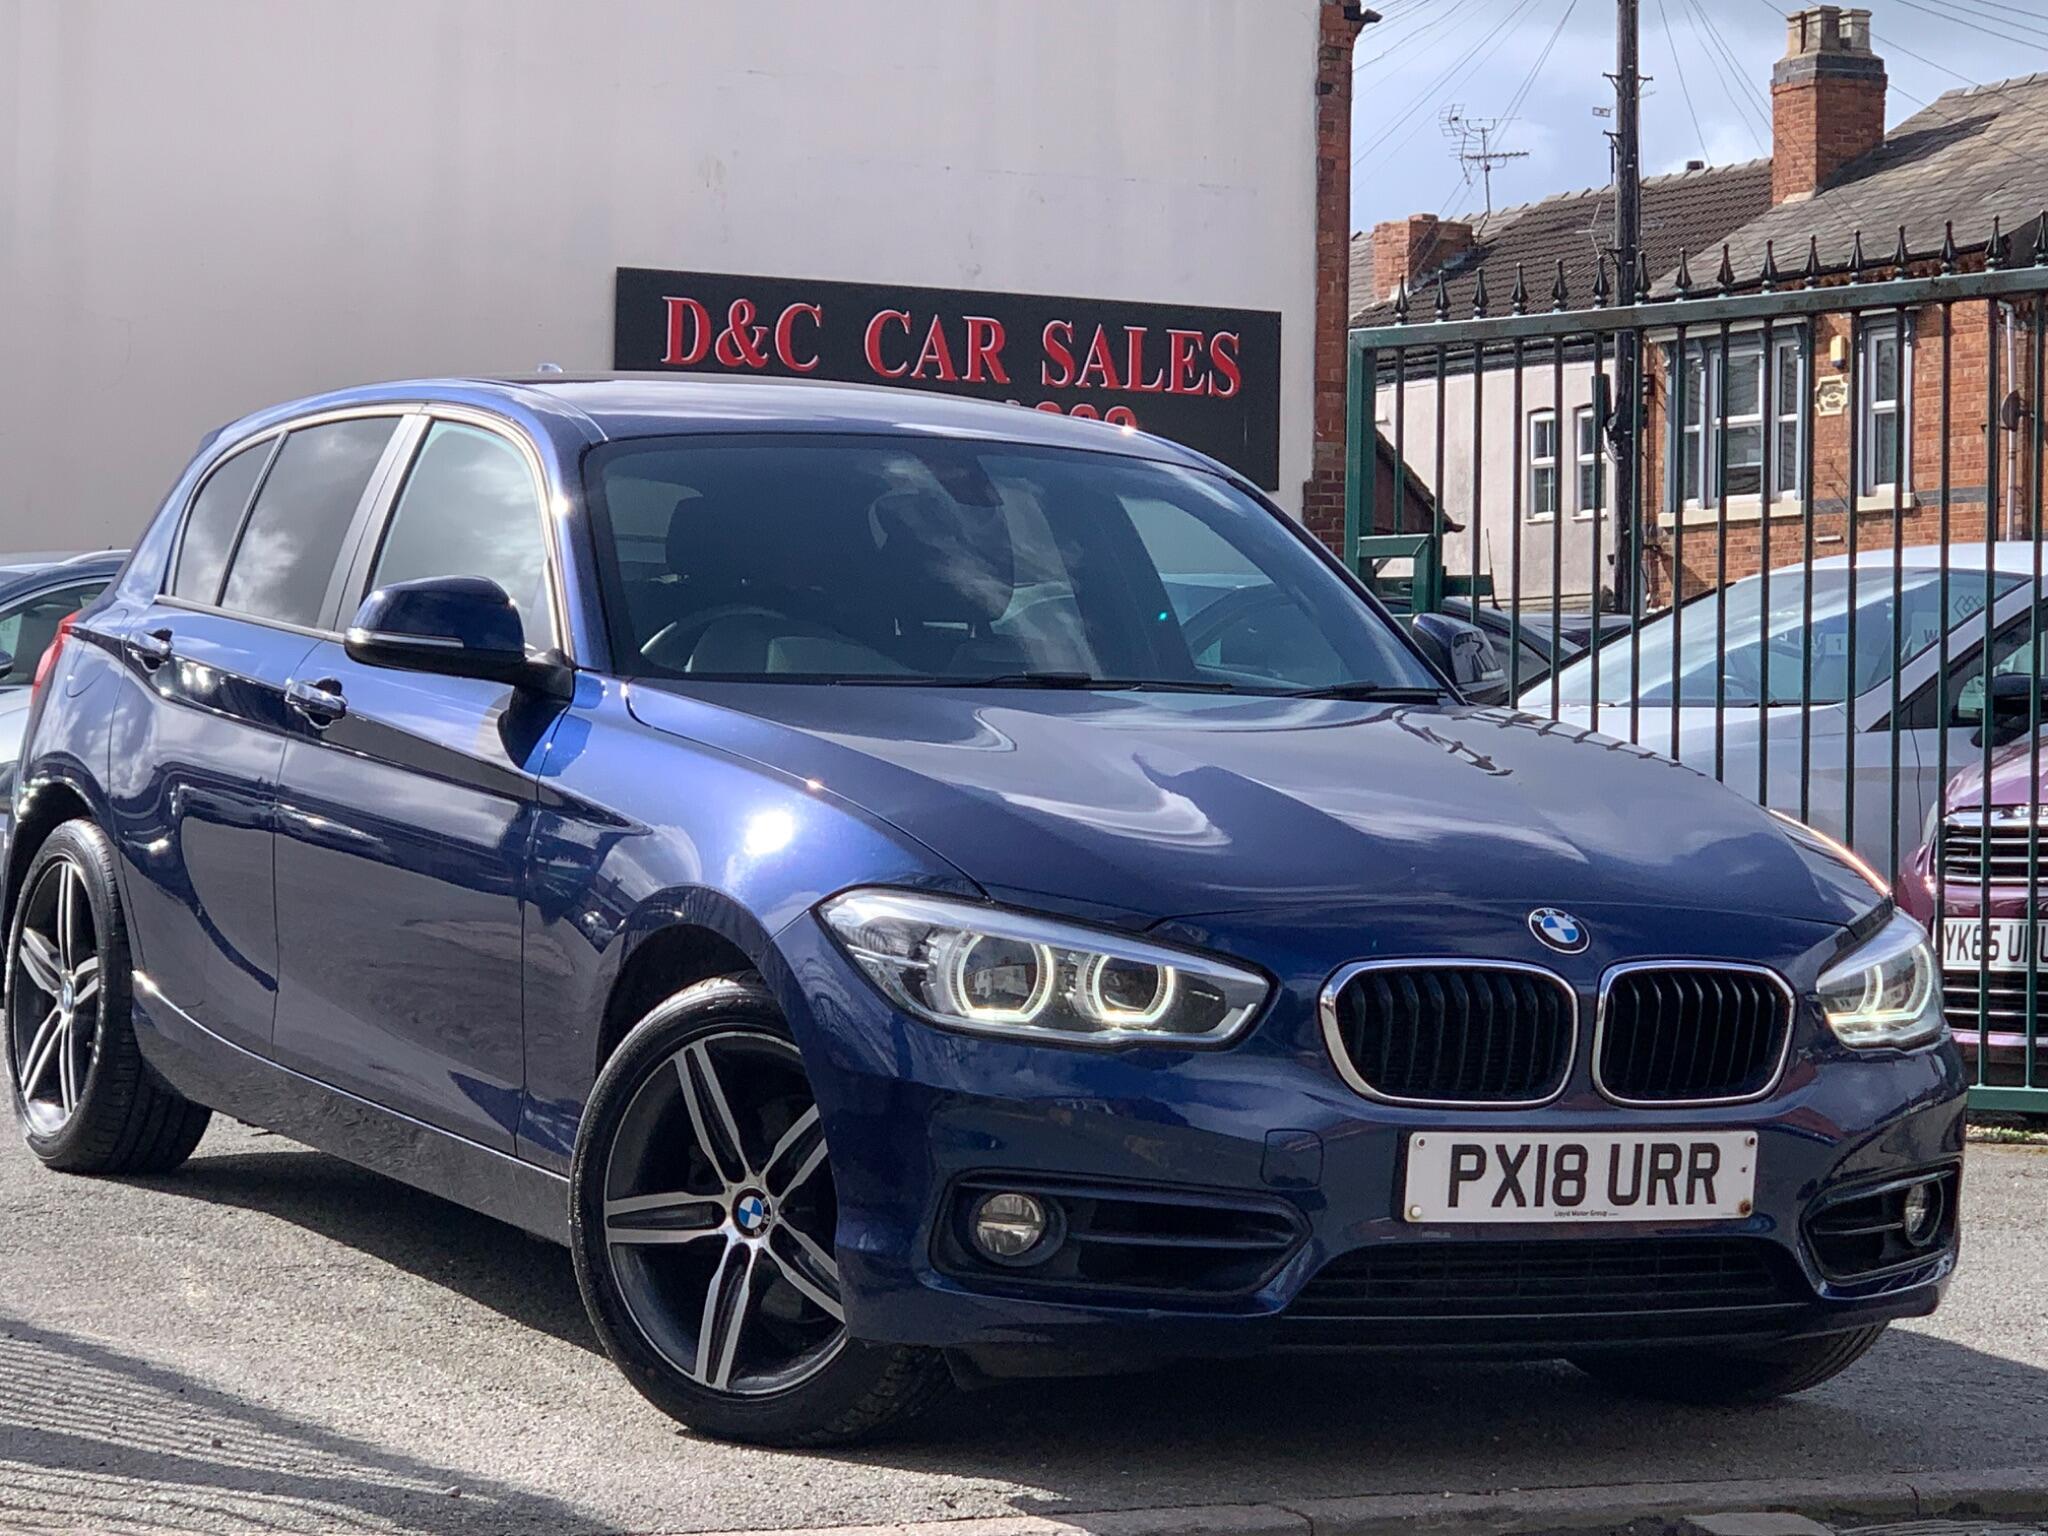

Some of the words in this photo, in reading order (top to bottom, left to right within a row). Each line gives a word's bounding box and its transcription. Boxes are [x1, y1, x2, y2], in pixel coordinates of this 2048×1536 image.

[661, 295, 822, 372] D&C
[864, 308, 1010, 385] CAR
[1041, 319, 1241, 399] SALES
[1448, 1143, 1589, 1208] PX18
[1607, 1142, 1721, 1206] URR
